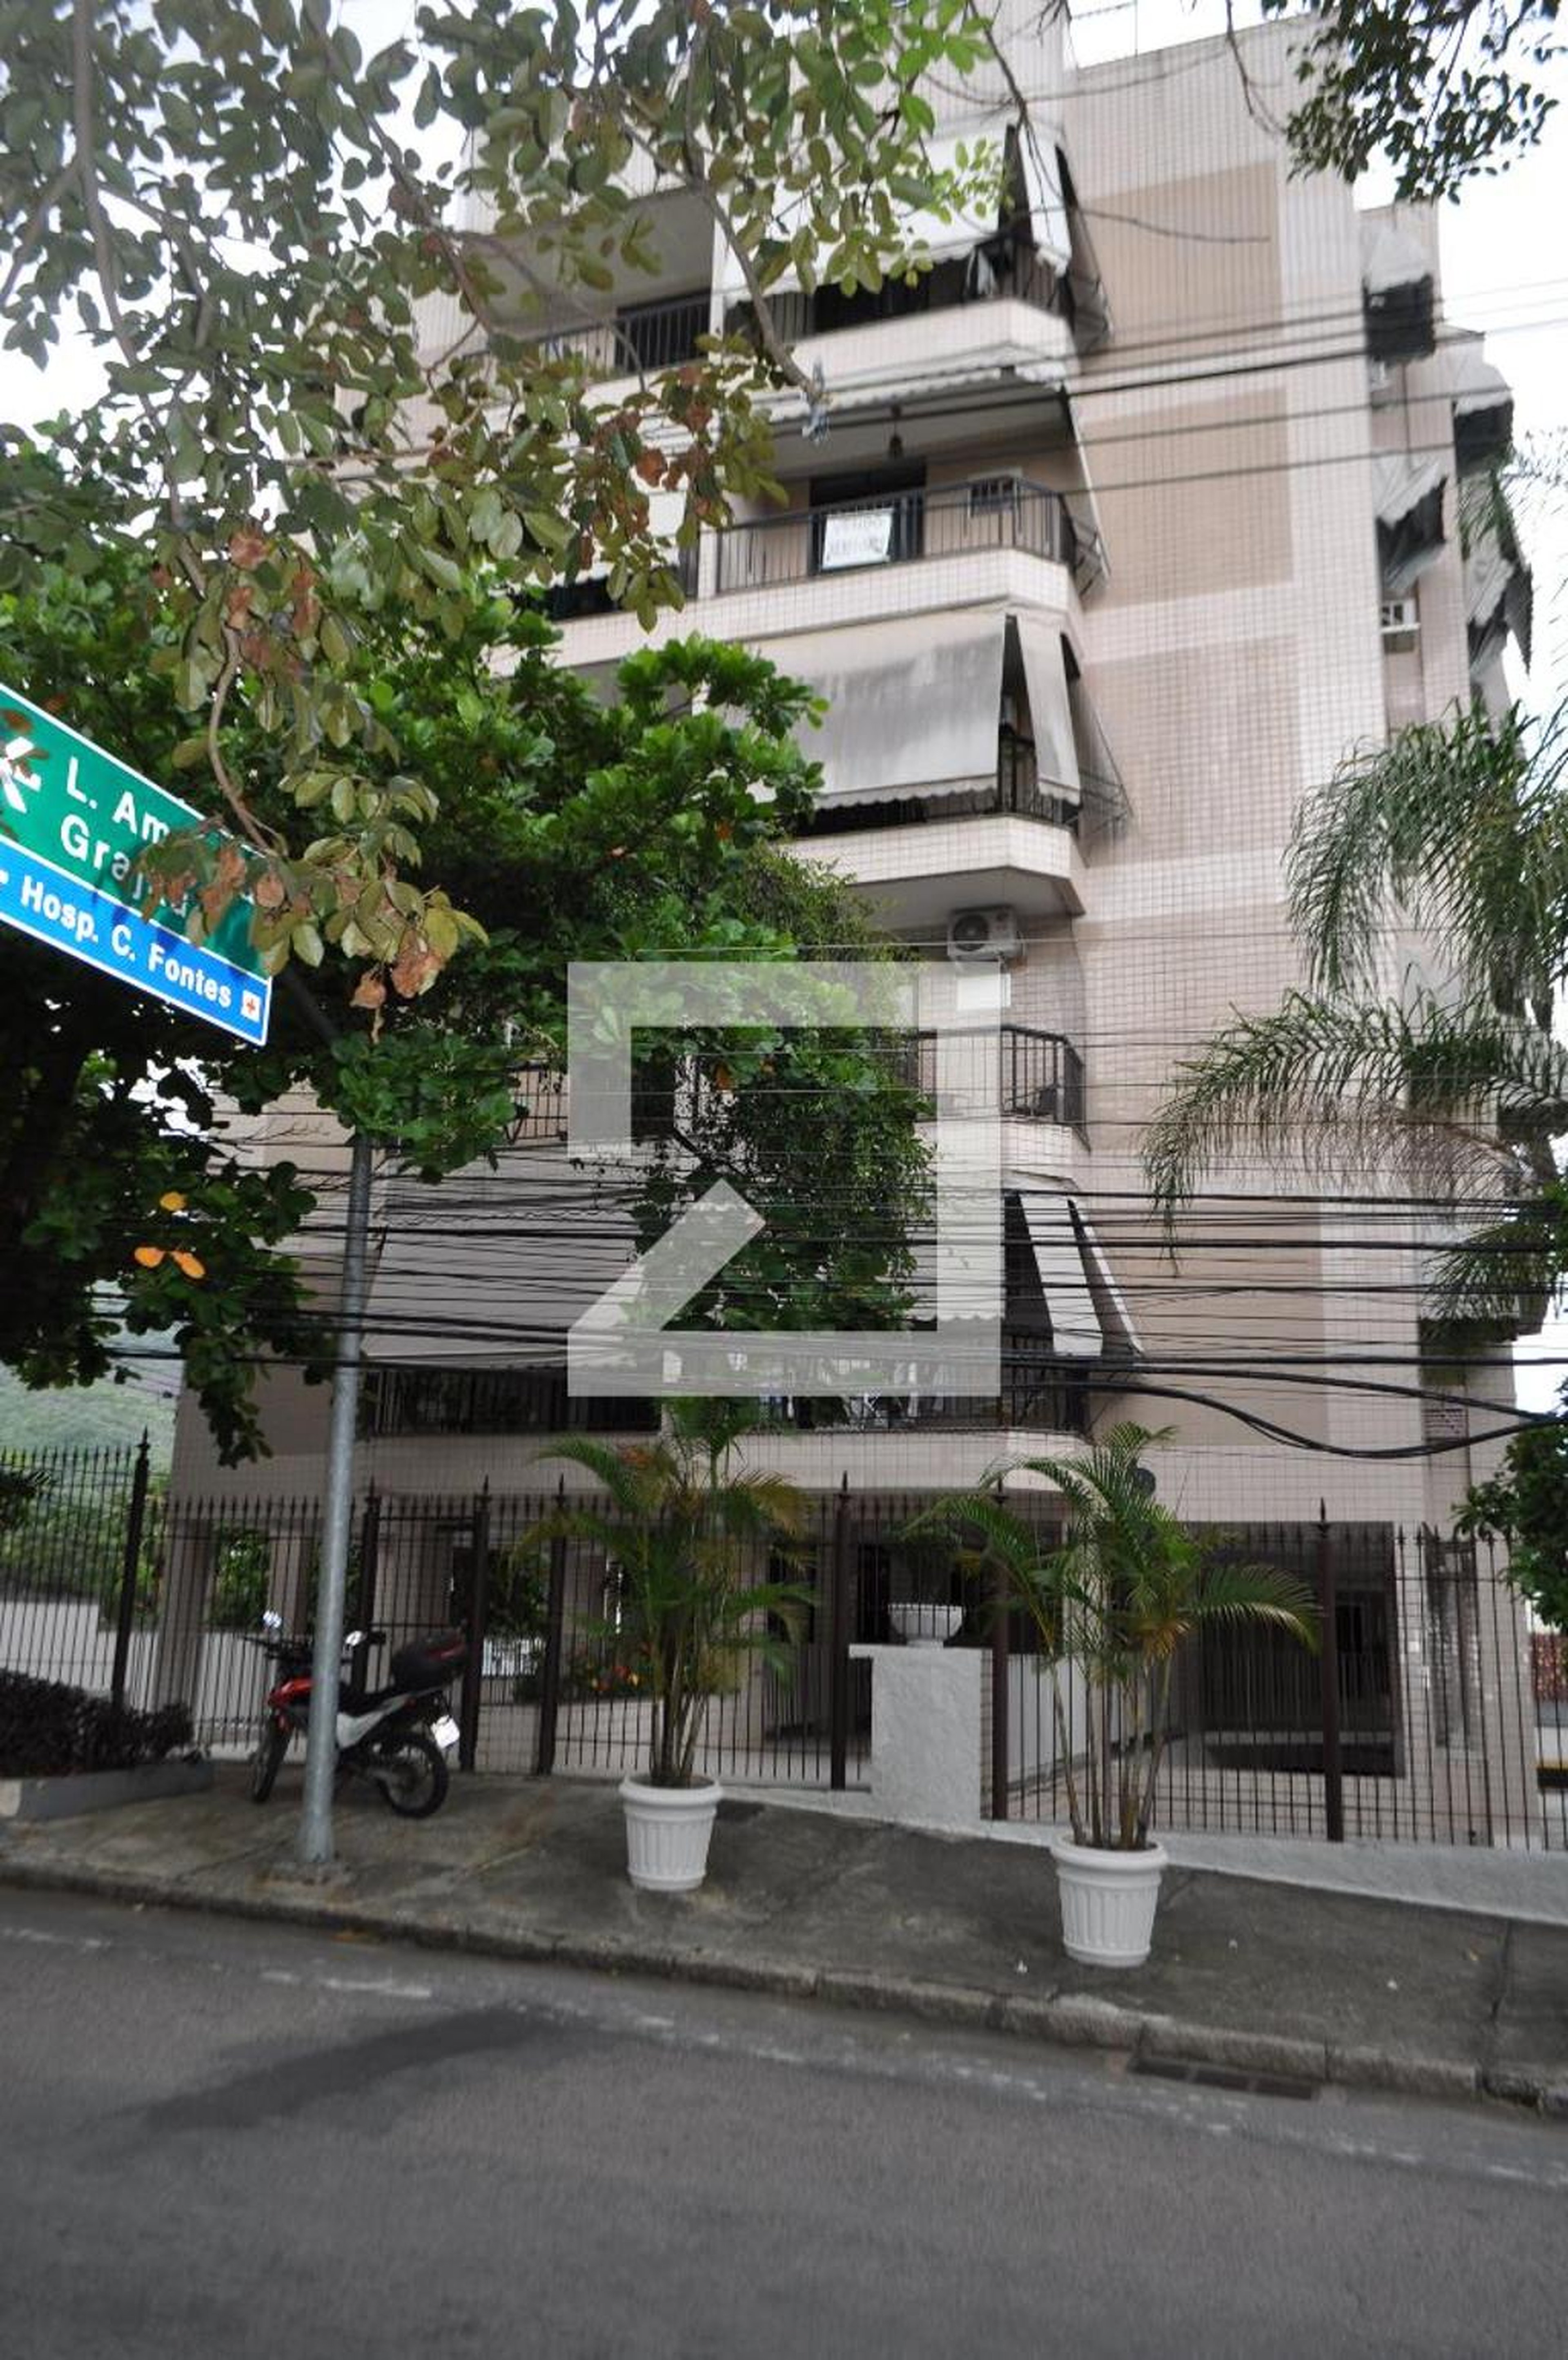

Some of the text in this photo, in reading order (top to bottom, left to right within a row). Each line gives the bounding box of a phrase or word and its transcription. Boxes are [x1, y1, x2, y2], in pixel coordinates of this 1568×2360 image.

[67, 755, 98, 809] L.
[21, 875, 232, 1008] Hosp. C. Fontes
